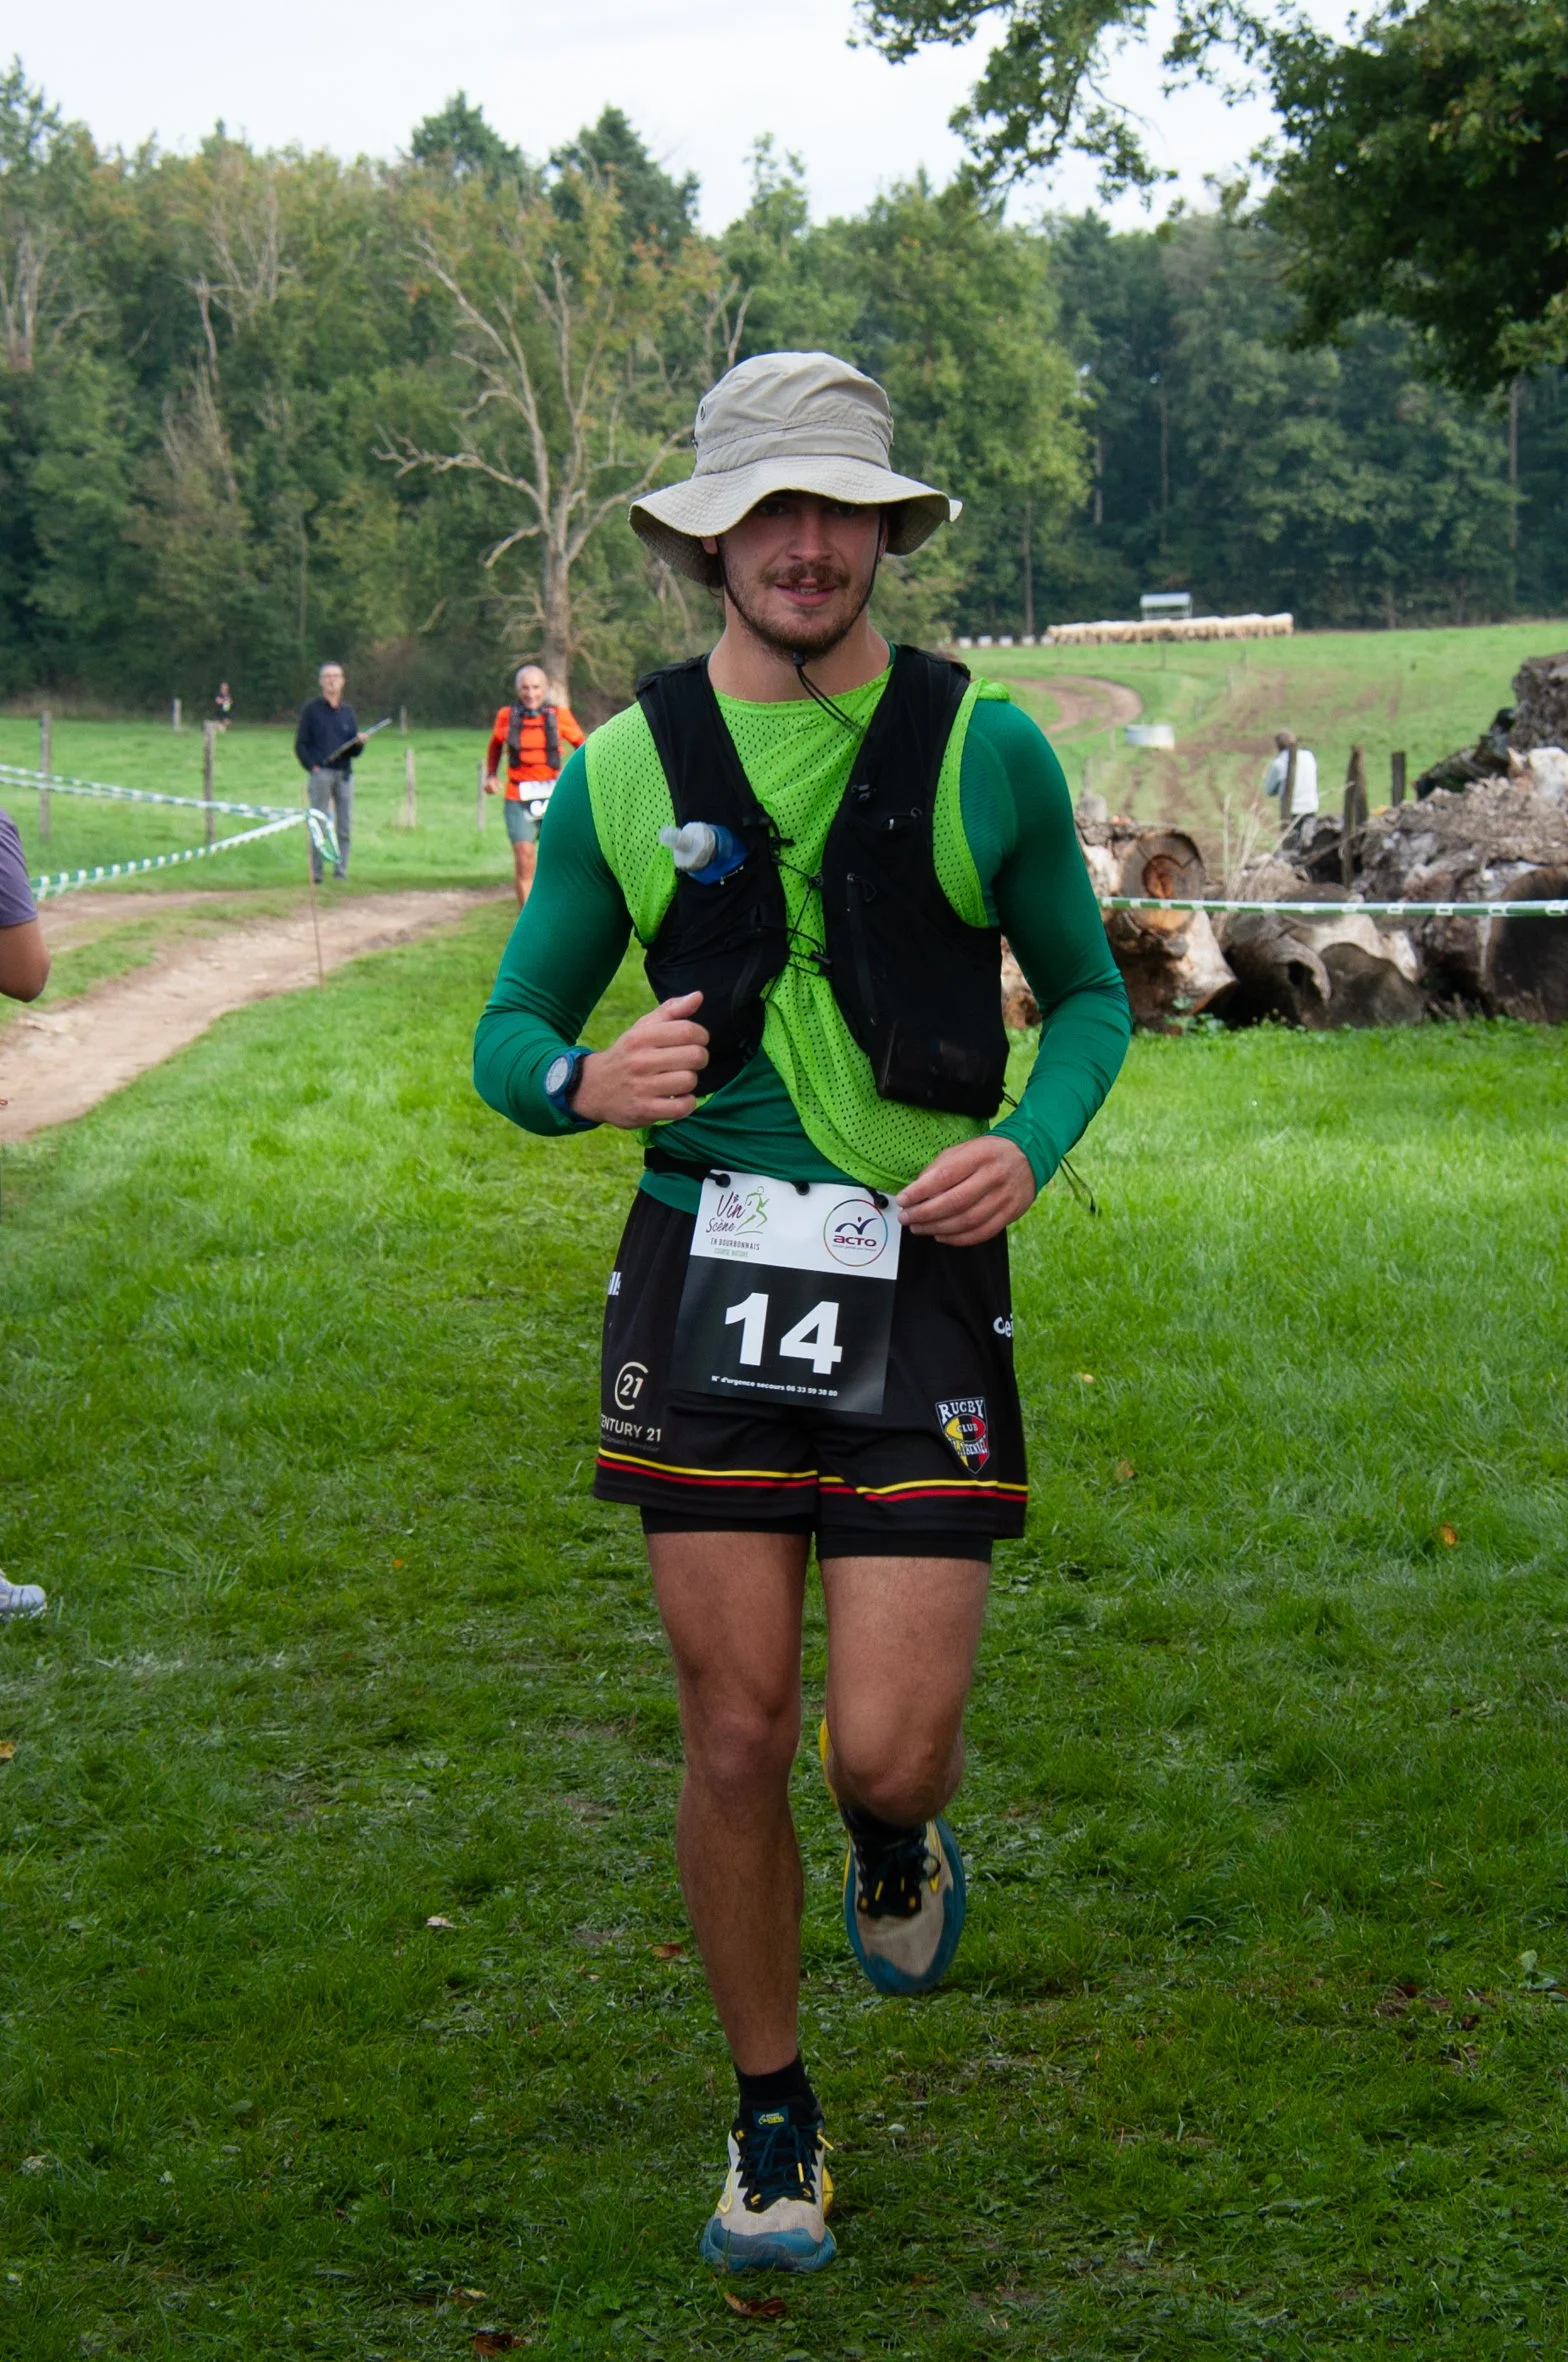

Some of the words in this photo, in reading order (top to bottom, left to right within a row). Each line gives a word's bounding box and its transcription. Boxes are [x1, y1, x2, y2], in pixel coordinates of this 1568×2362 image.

[717, 1191, 746, 1219] Vin
[706, 1218, 736, 1233] Scène
[719, 1238, 760, 1251] BOURBONNAIS
[725, 1292, 843, 1375] 14
[620, 1373, 644, 1399] 21
[720, 1376, 755, 1387] d'urgence
[756, 1382, 785, 1391] secours
[786, 1384, 796, 1392] 06
[797, 1385, 806, 1393] 33
[938, 1399, 984, 1425] RUGBY
[600, 1413, 643, 1438] ENTURY
[646, 1427, 662, 1442] 21
[956, 1423, 979, 1433] CLUB
